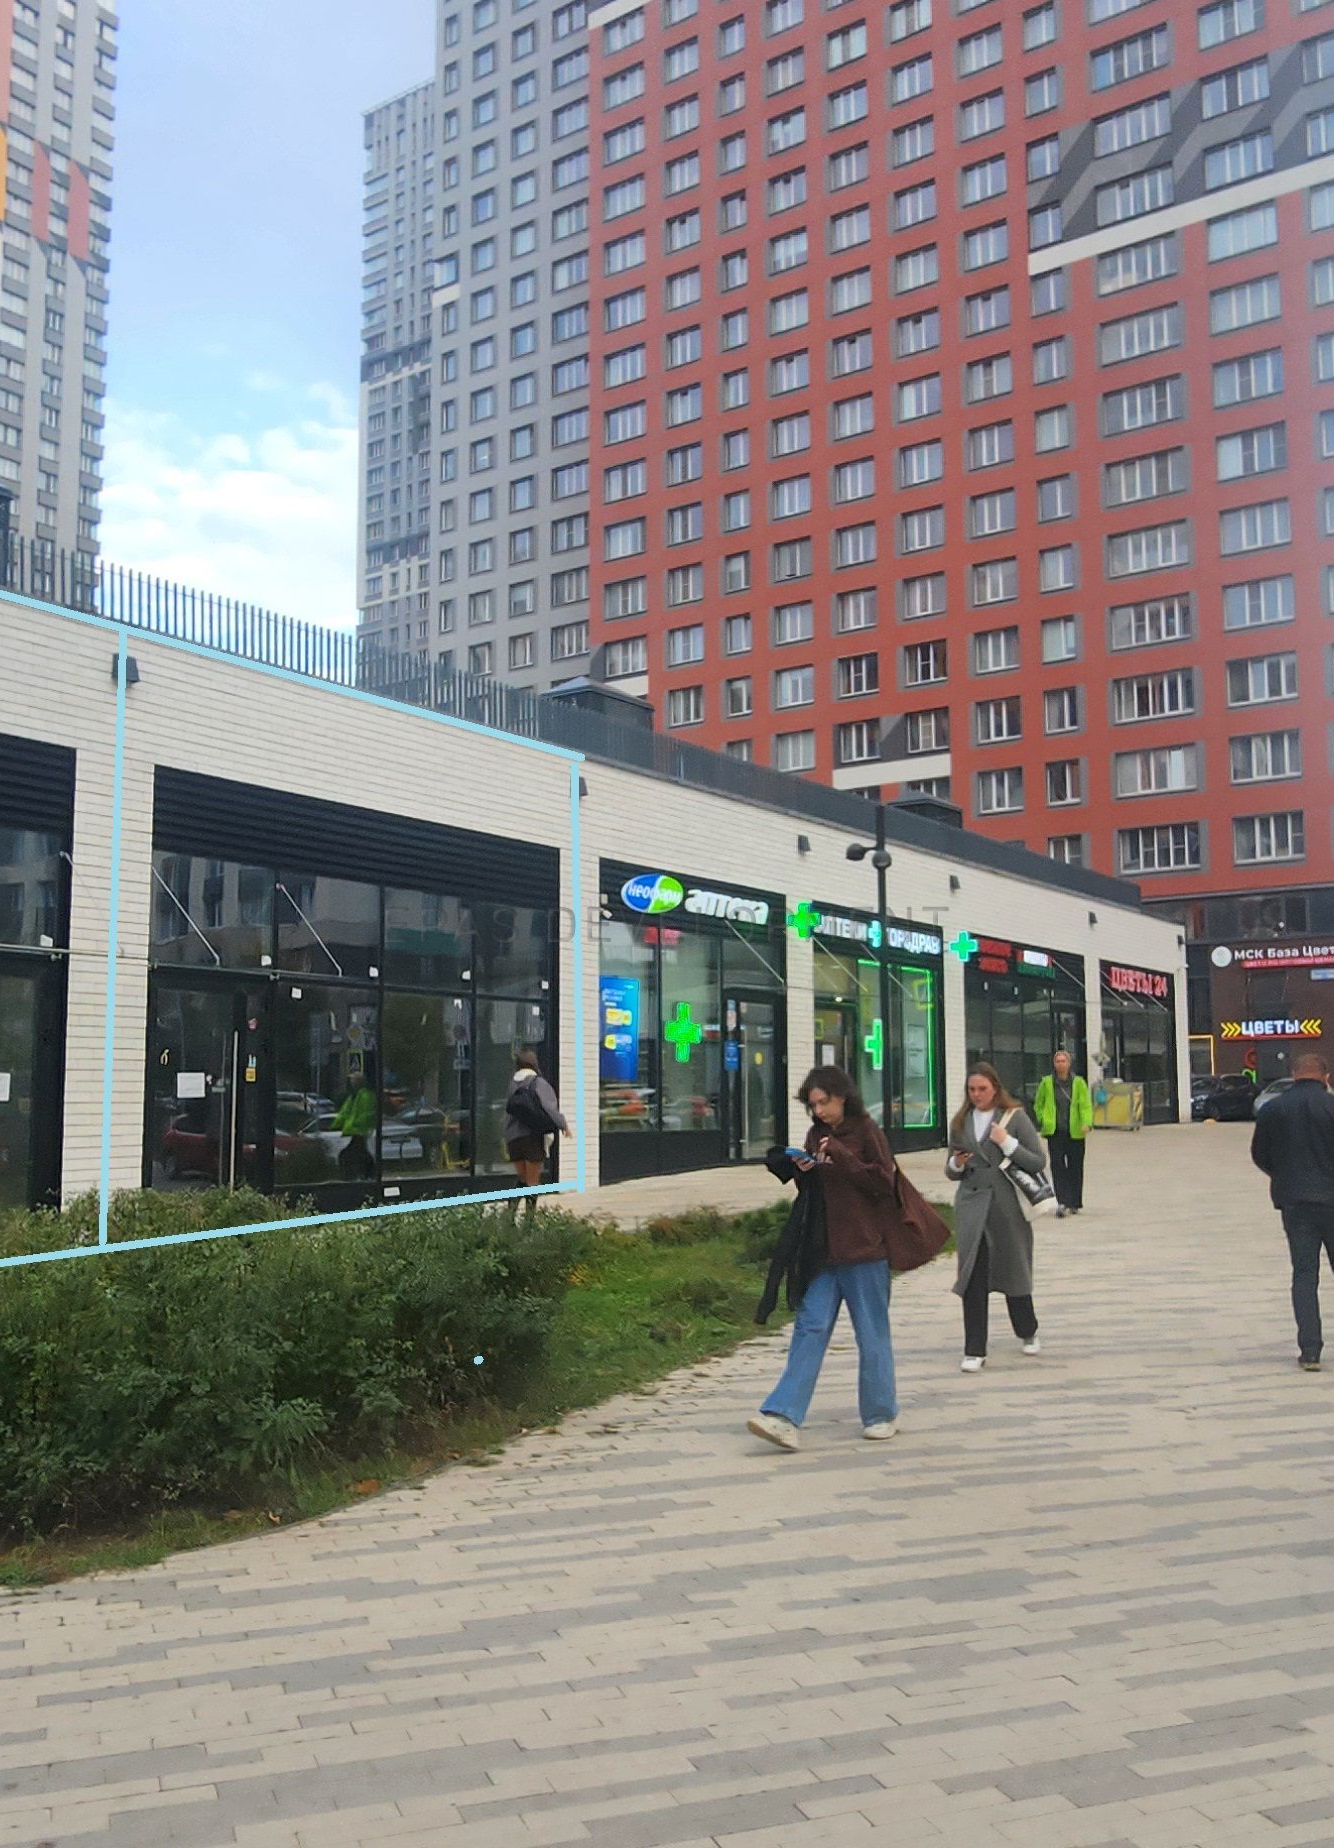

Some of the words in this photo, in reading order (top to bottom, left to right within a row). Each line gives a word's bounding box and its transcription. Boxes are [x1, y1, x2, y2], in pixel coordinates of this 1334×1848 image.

[684, 889, 769, 925] аптека
[1234, 949, 1264, 961] МСК
[1267, 948, 1299, 959] База
[1110, 966, 1154, 995] ЦВЕТЫ
[1154, 975, 1168, 998] 24
[1241, 1019, 1300, 1036] ЦВЕТЫ
